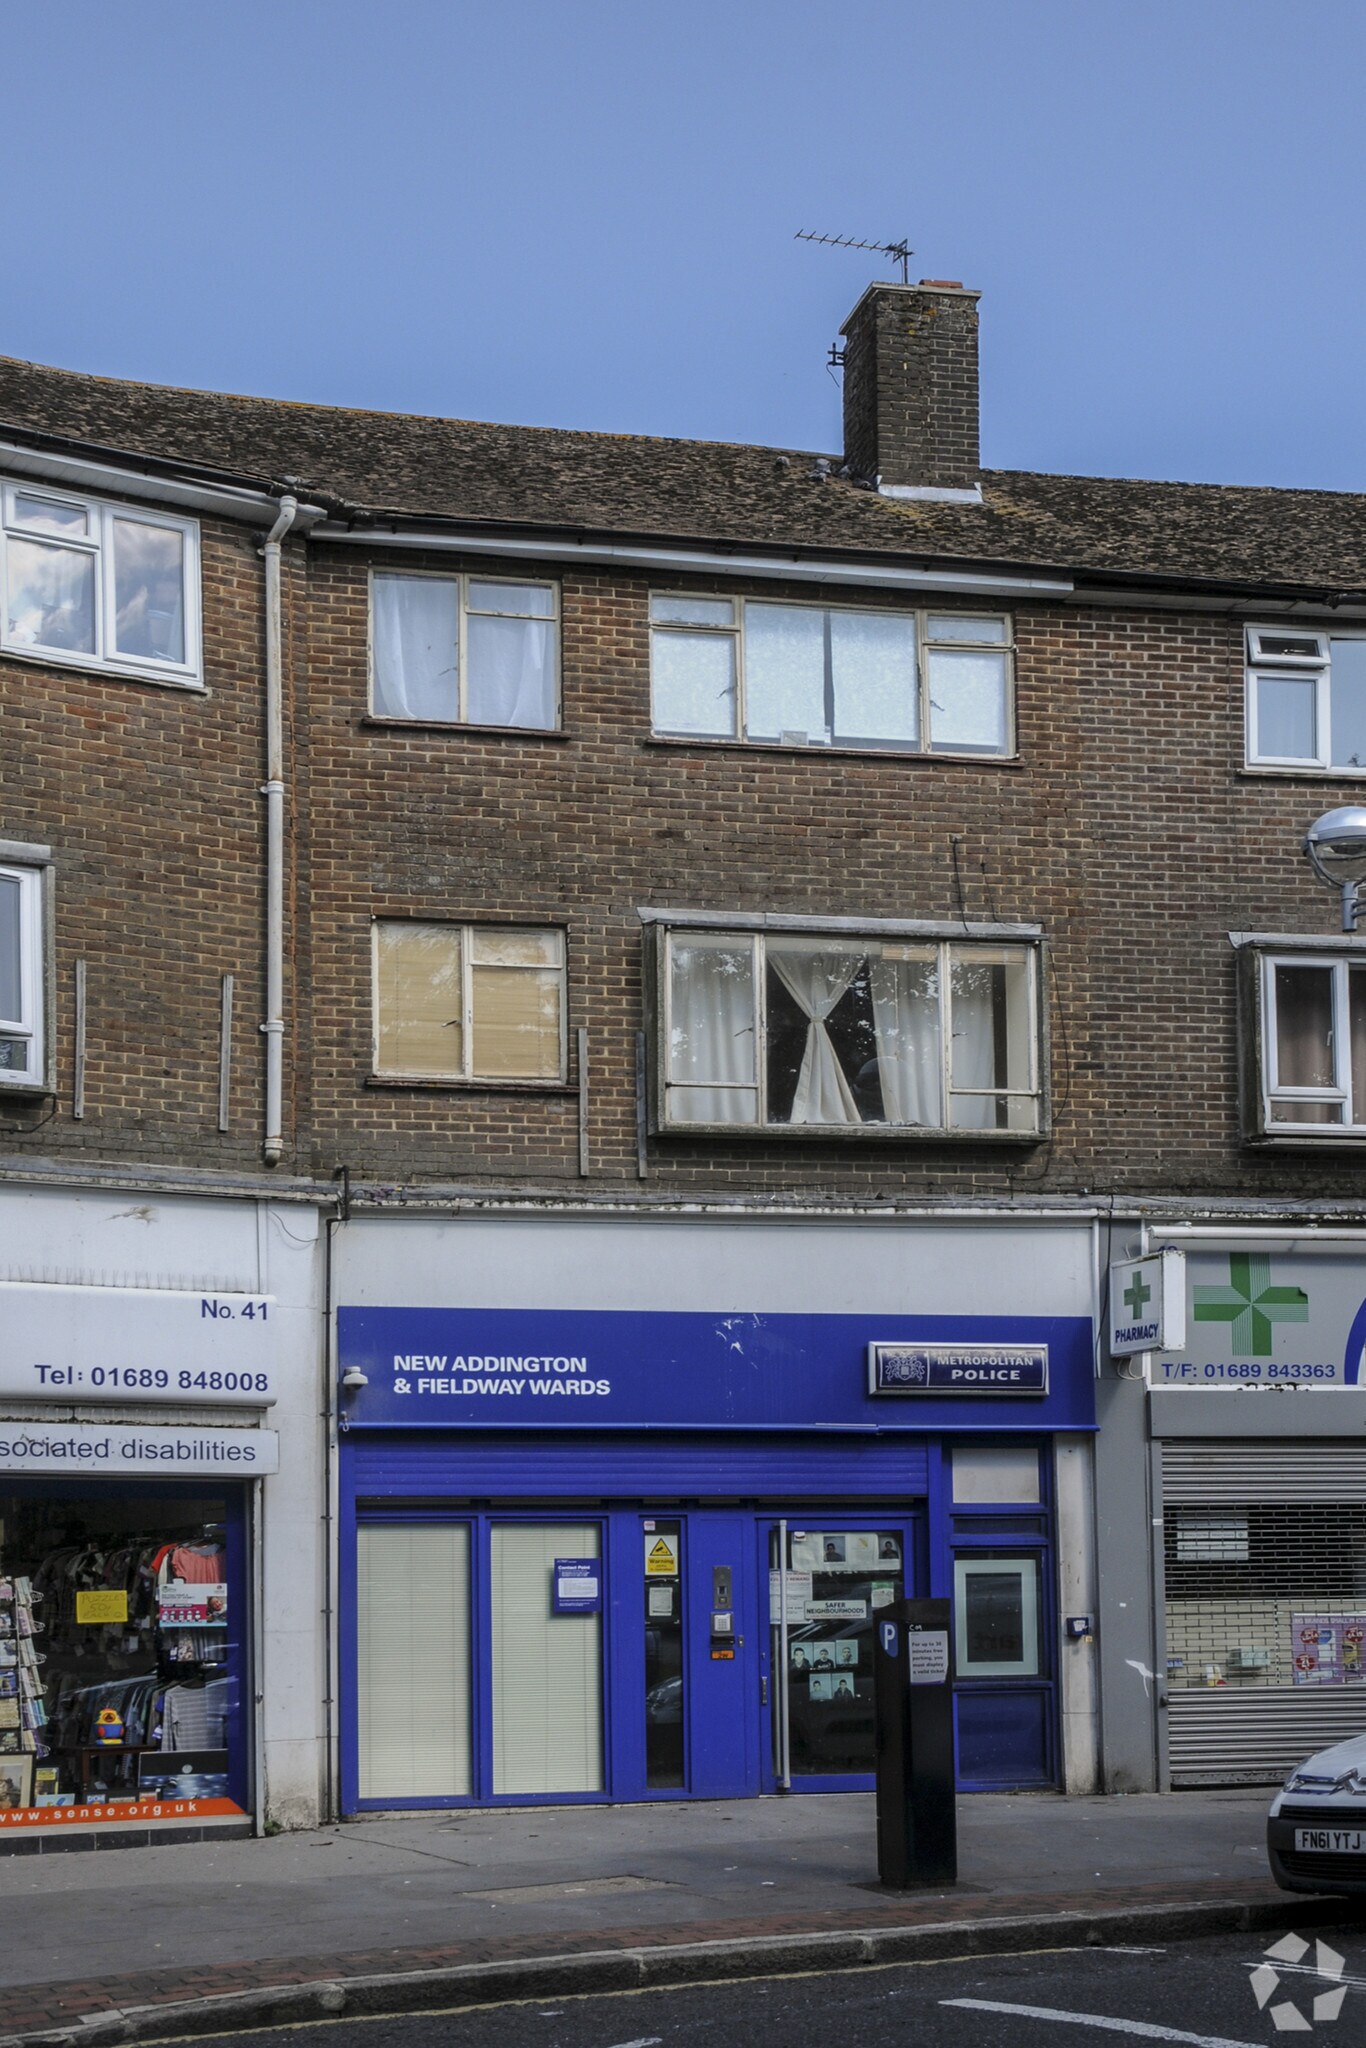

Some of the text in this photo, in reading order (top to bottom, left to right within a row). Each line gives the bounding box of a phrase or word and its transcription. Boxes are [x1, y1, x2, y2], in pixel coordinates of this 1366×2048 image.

[201, 1299, 268, 1320] No. 41
[1115, 1322, 1159, 1343] PHARMACY
[393, 1355, 587, 1373] NEW ADDINGTON
[937, 1356, 1034, 1366] METROPOLITAN
[1161, 1362, 1336, 1379] T/F: 01689 843363
[34, 1364, 268, 1392] Tel: 01689 848008
[951, 1369, 1021, 1381] POLICE
[393, 1378, 611, 1396] & FIELDWAY WARDS
[121, 1439, 256, 1461] disabilities
[884, 1624, 896, 1650] P
[1302, 1831, 1361, 1850] FN61 YTJ
